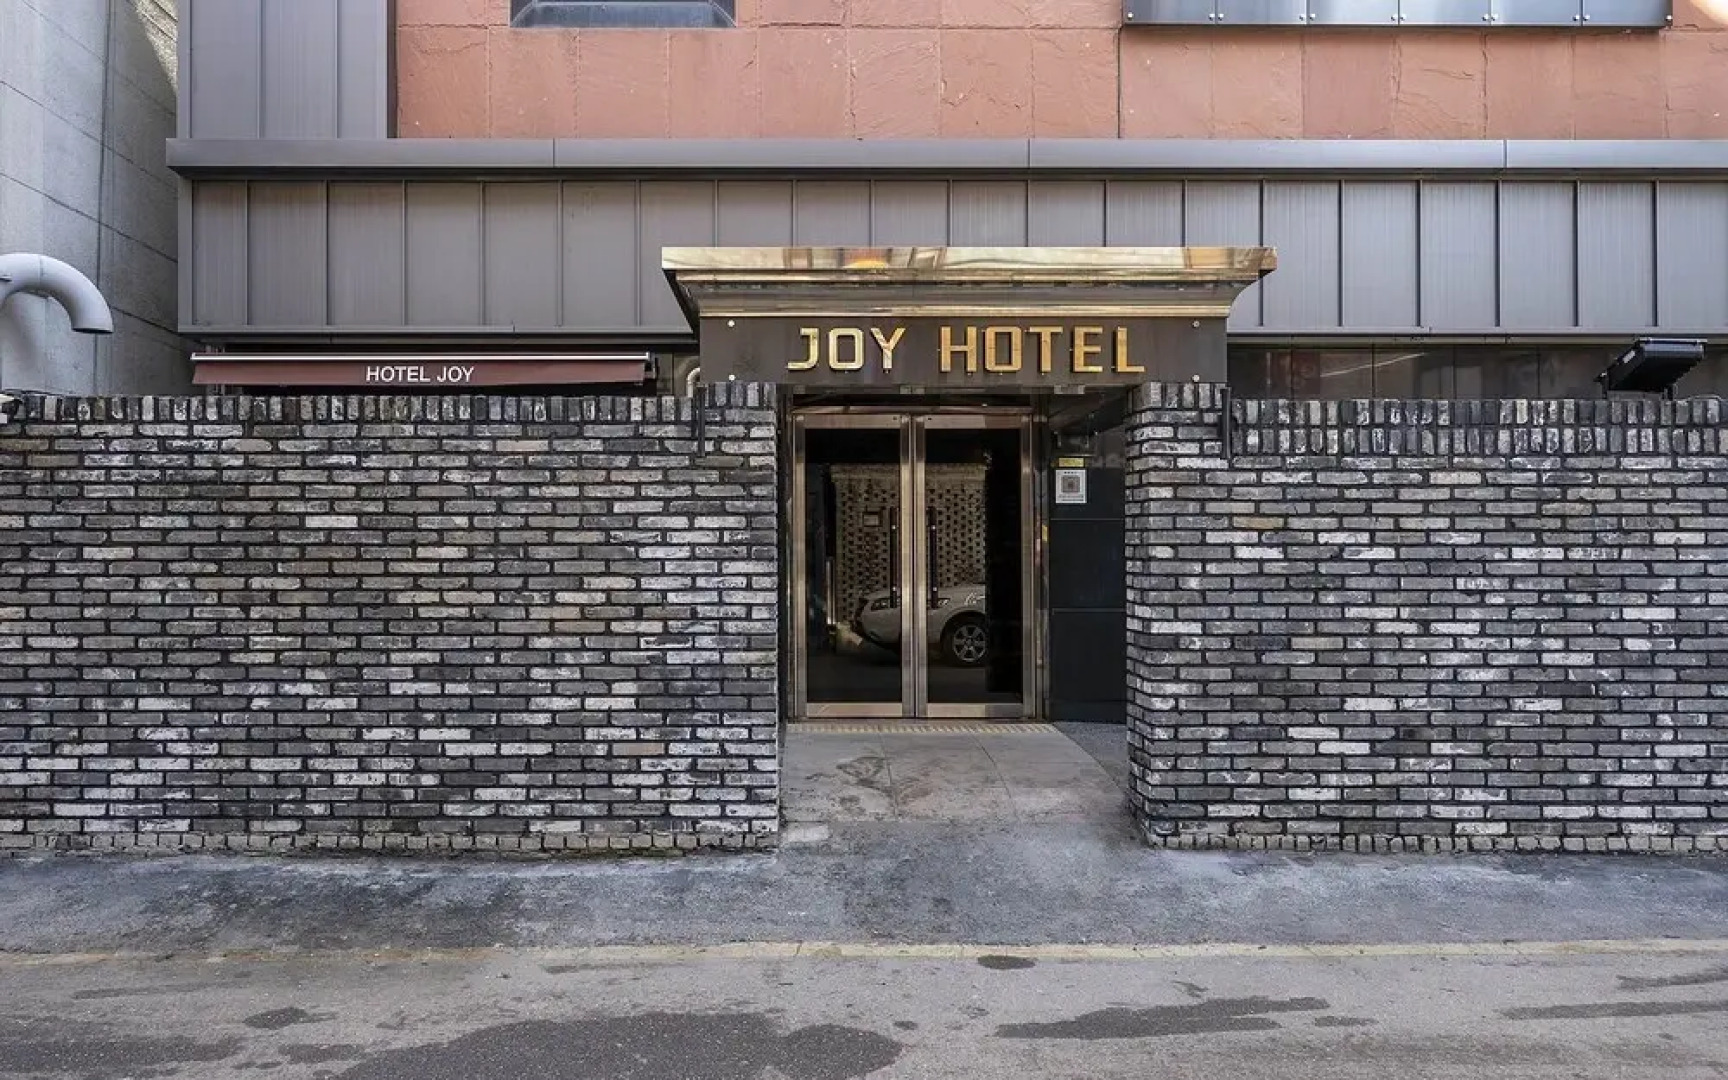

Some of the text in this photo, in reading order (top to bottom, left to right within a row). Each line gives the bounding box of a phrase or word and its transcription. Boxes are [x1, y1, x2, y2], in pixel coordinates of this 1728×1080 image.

[787, 326, 1145, 373] JOY HOTEL
[365, 366, 475, 382] HOTEL JOY
